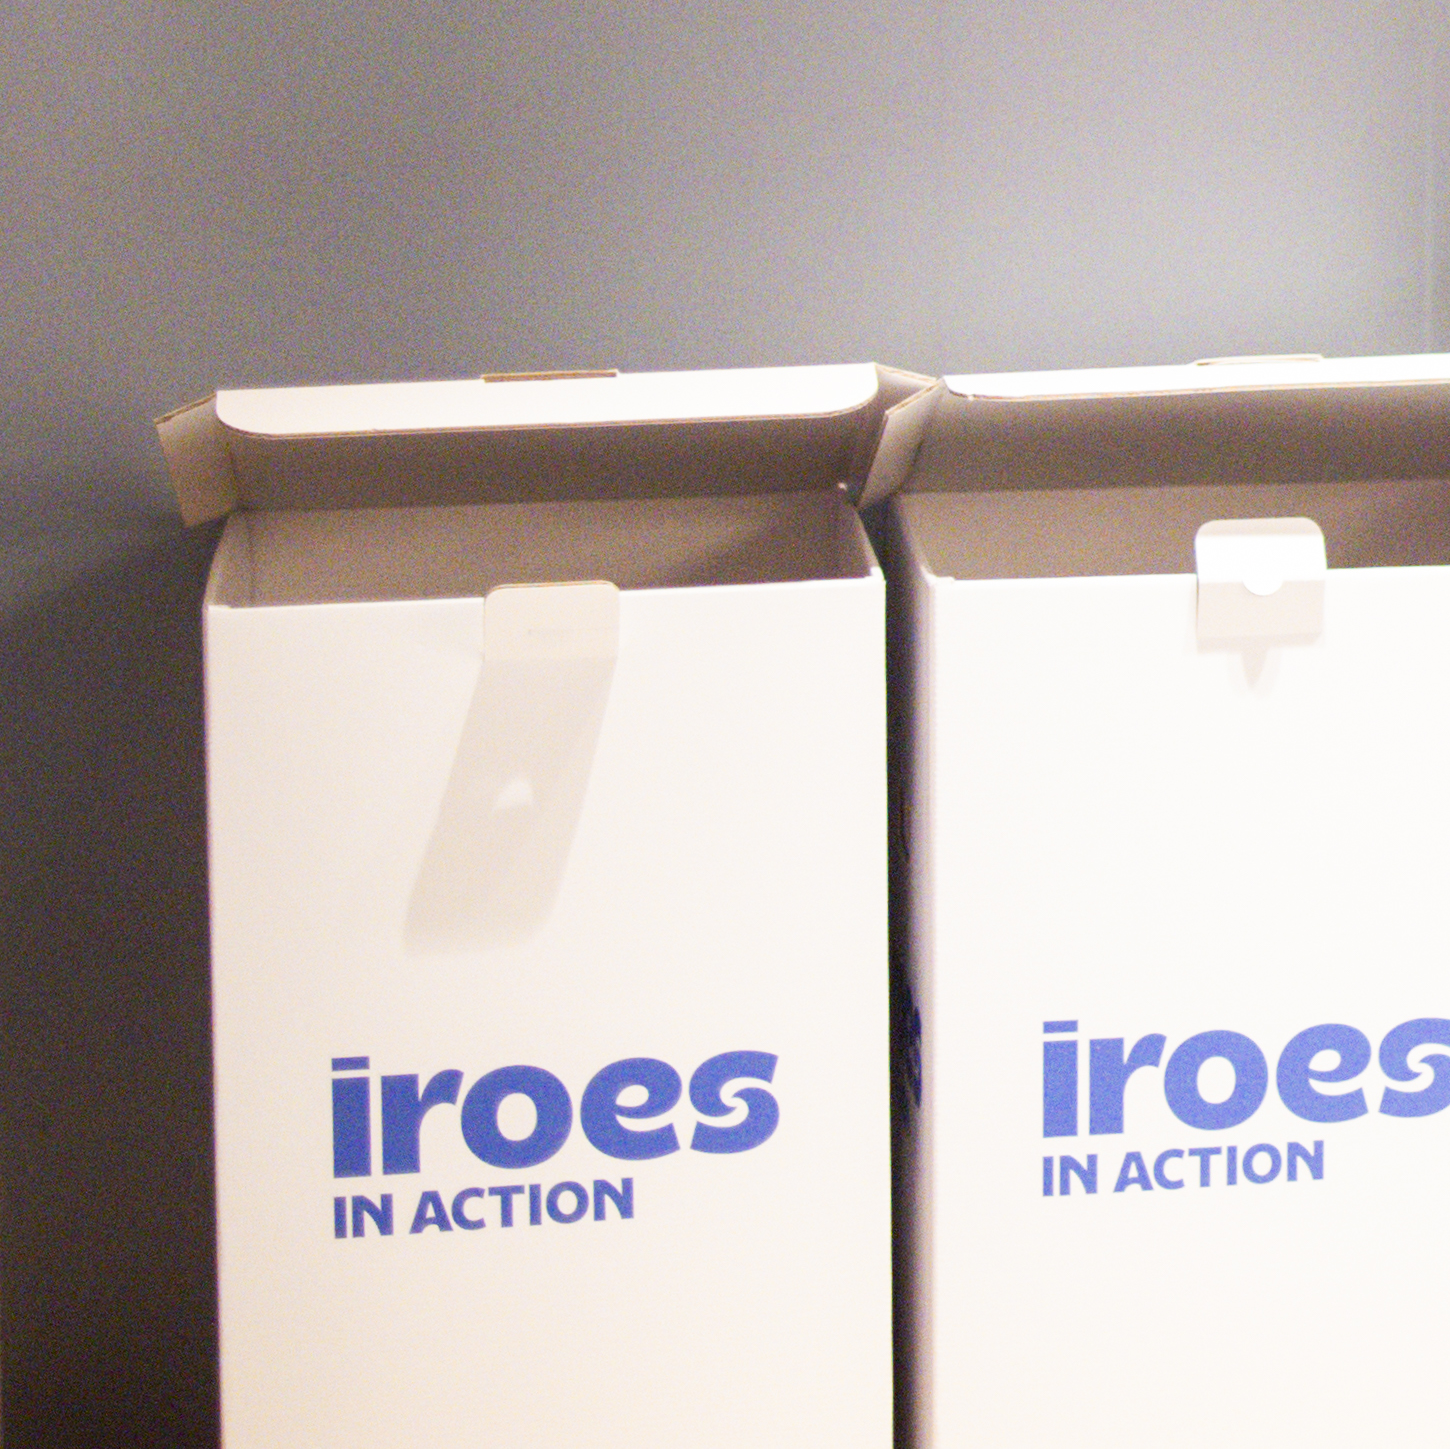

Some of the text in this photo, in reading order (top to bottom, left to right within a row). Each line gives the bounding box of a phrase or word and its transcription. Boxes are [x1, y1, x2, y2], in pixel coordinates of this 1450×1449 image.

[331, 1050, 781, 1179] iroes
[1042, 1139, 1325, 1197] IN ACTION
[332, 1177, 635, 1239] IN ACTION
